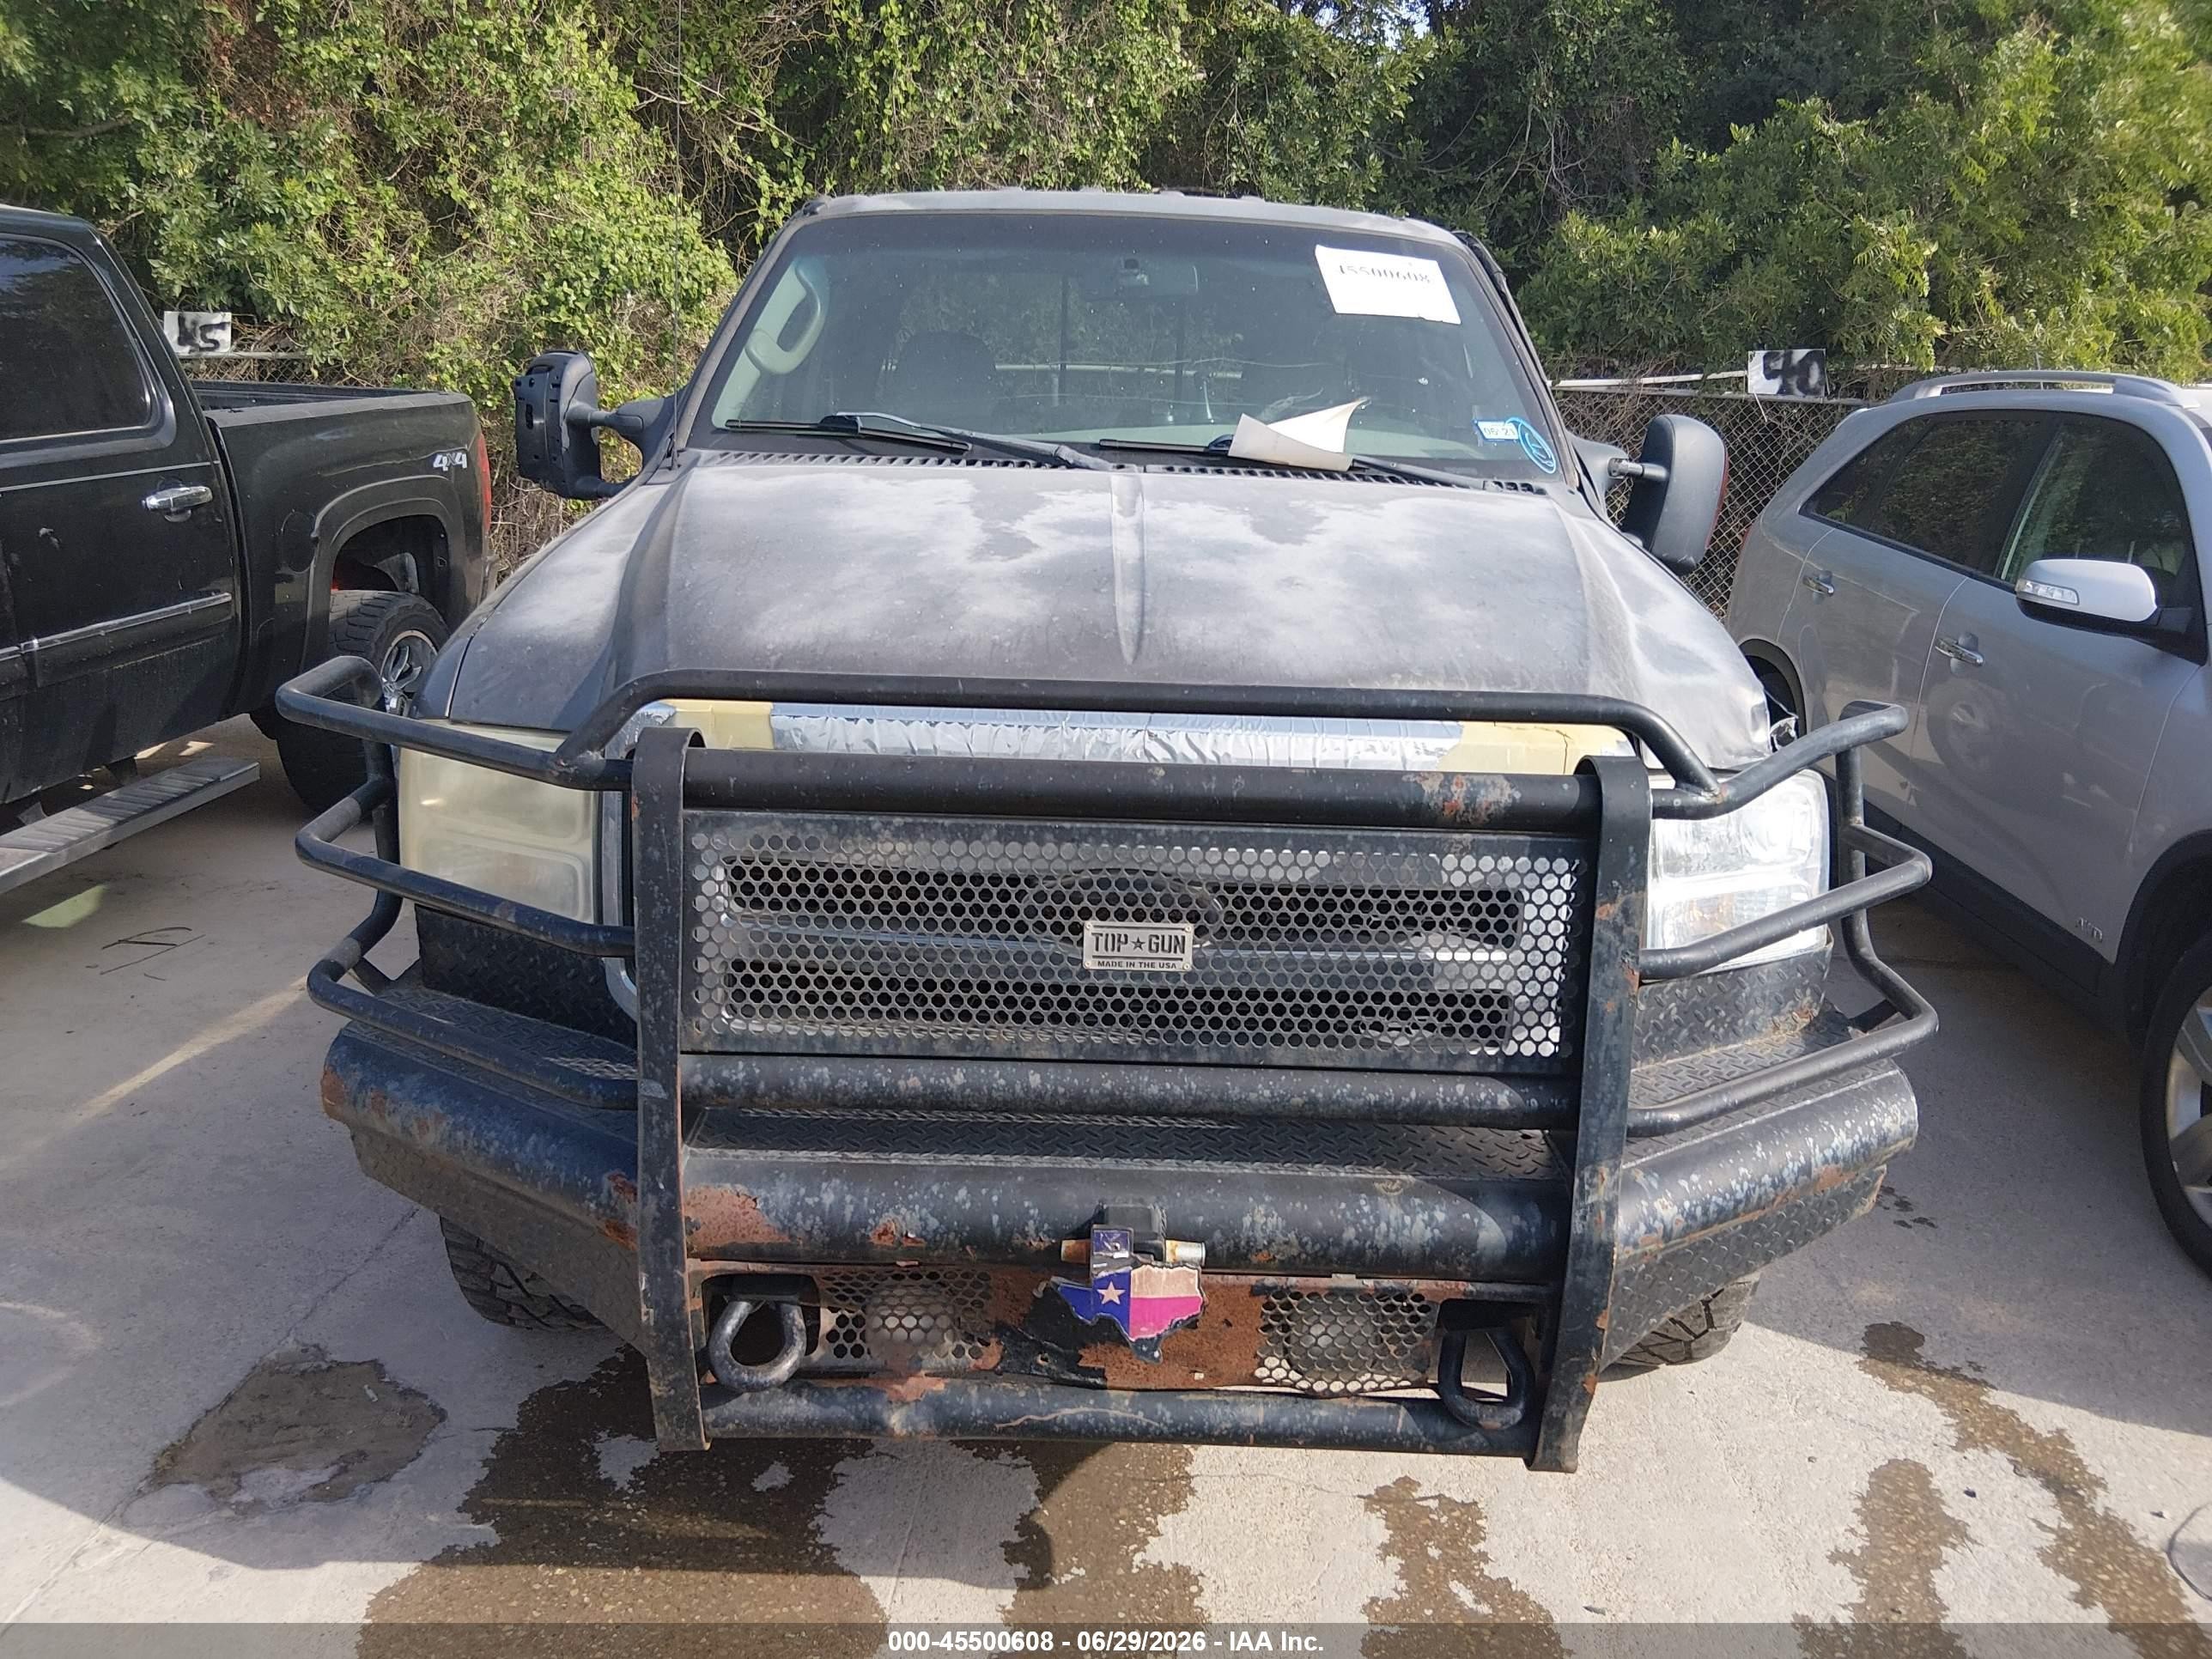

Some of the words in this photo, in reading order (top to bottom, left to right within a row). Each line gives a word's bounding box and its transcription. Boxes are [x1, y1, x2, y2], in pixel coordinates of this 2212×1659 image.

[1091, 933, 1128, 952] TOP
[1148, 934, 1186, 954] GUN
[1097, 960, 1123, 969] MADE
